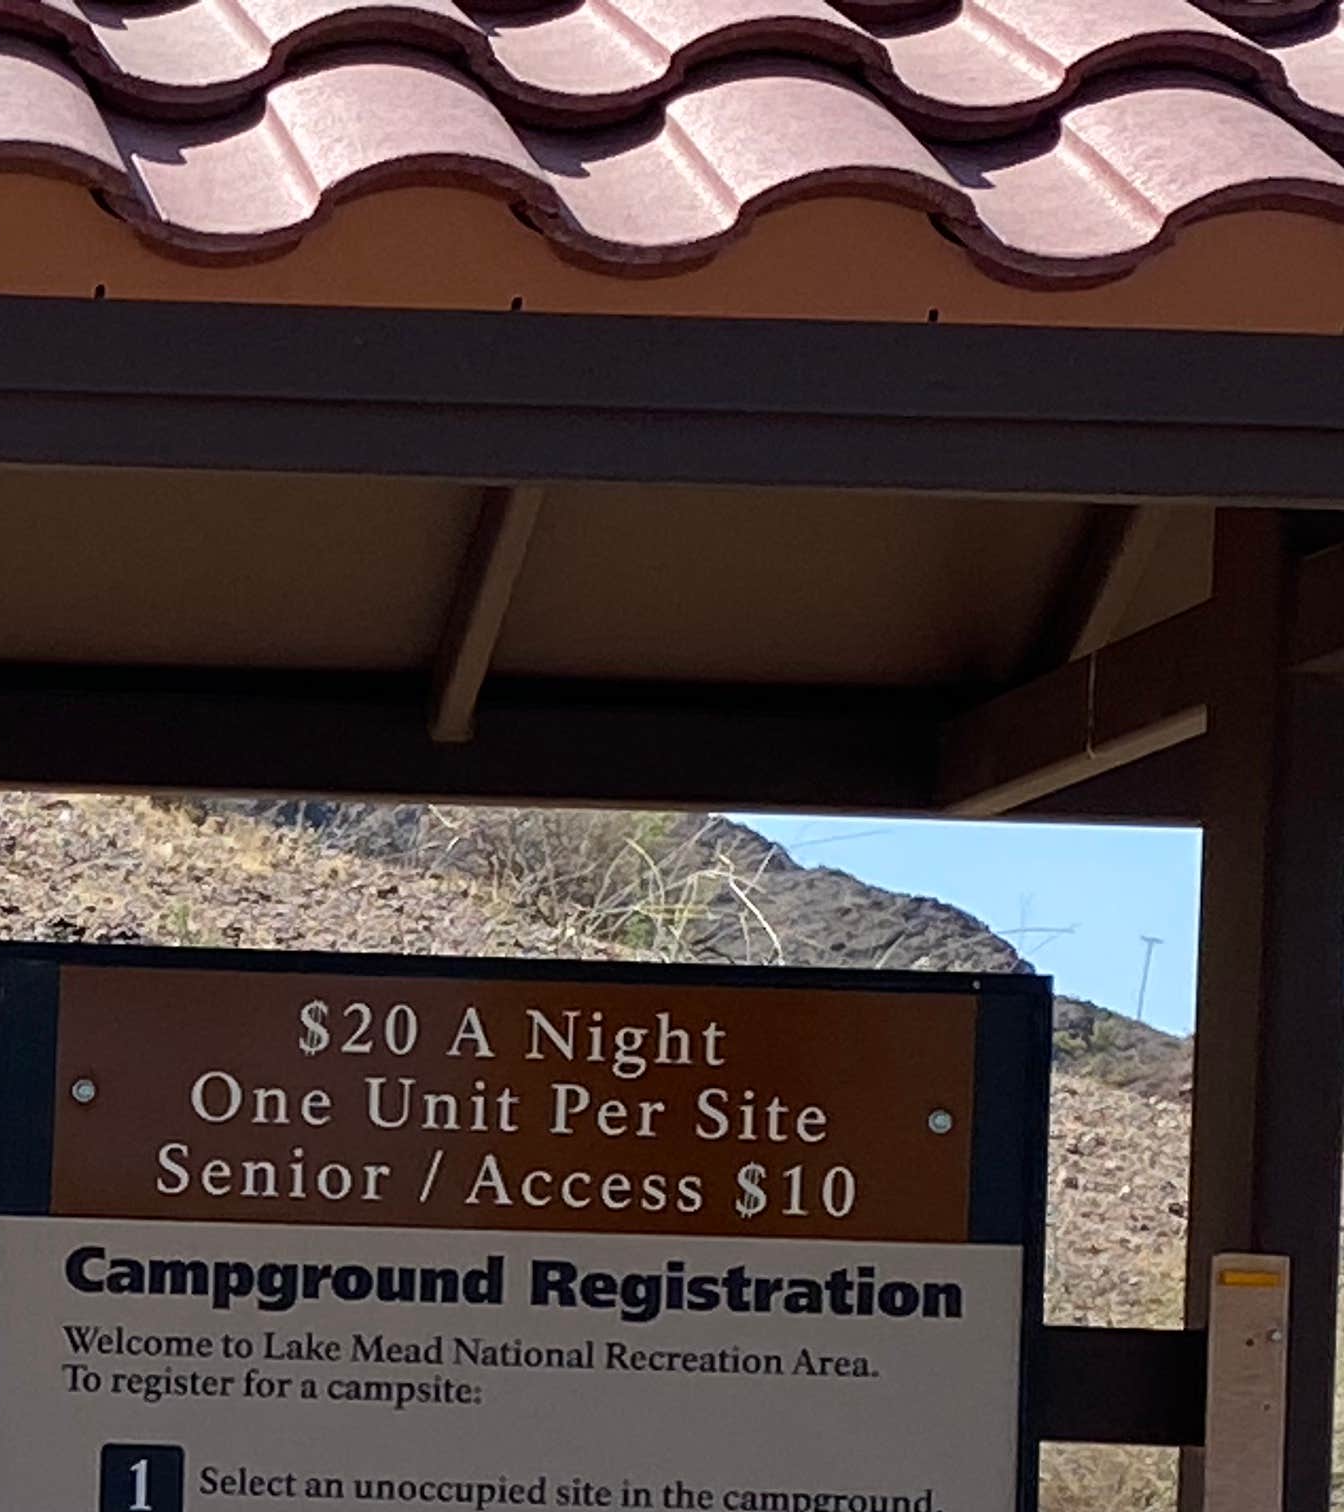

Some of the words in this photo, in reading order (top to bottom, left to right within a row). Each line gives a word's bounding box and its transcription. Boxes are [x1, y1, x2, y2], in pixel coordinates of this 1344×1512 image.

[298, 1001, 418, 1056] $20
[447, 1014, 496, 1059] A
[526, 1010, 727, 1079] Night
[191, 1072, 332, 1126] One
[366, 1078, 521, 1134] Unit
[552, 1084, 666, 1139] Per
[696, 1089, 828, 1144] Site
[157, 1144, 390, 1201] Senior
[466, 1158, 702, 1212] Access
[736, 1162, 857, 1220] $10
[64, 1246, 504, 1312] Campground
[530, 1259, 963, 1323] Registration
[61, 1364, 101, 1395] To
[111, 1367, 234, 1402] register
[242, 1369, 292, 1399] for
[301, 1379, 318, 1399] a
[327, 1374, 483, 1409] campsite:
[63, 1326, 213, 1357] Welcome
[222, 1333, 253, 1359] to
[263, 1333, 341, 1361] Lake
[351, 1334, 443, 1365] Mead
[452, 1335, 595, 1369] National
[606, 1341, 783, 1375] Recreation
[792, 1348, 880, 1378] Area.
[129, 1458, 152, 1512] 1
[199, 1467, 297, 1497] Select
[305, 1477, 344, 1499] an
[353, 1474, 547, 1511] unoccupied
[555, 1478, 612, 1508] site
[621, 1478, 653, 1509] in
[663, 1481, 713, 1511] the
